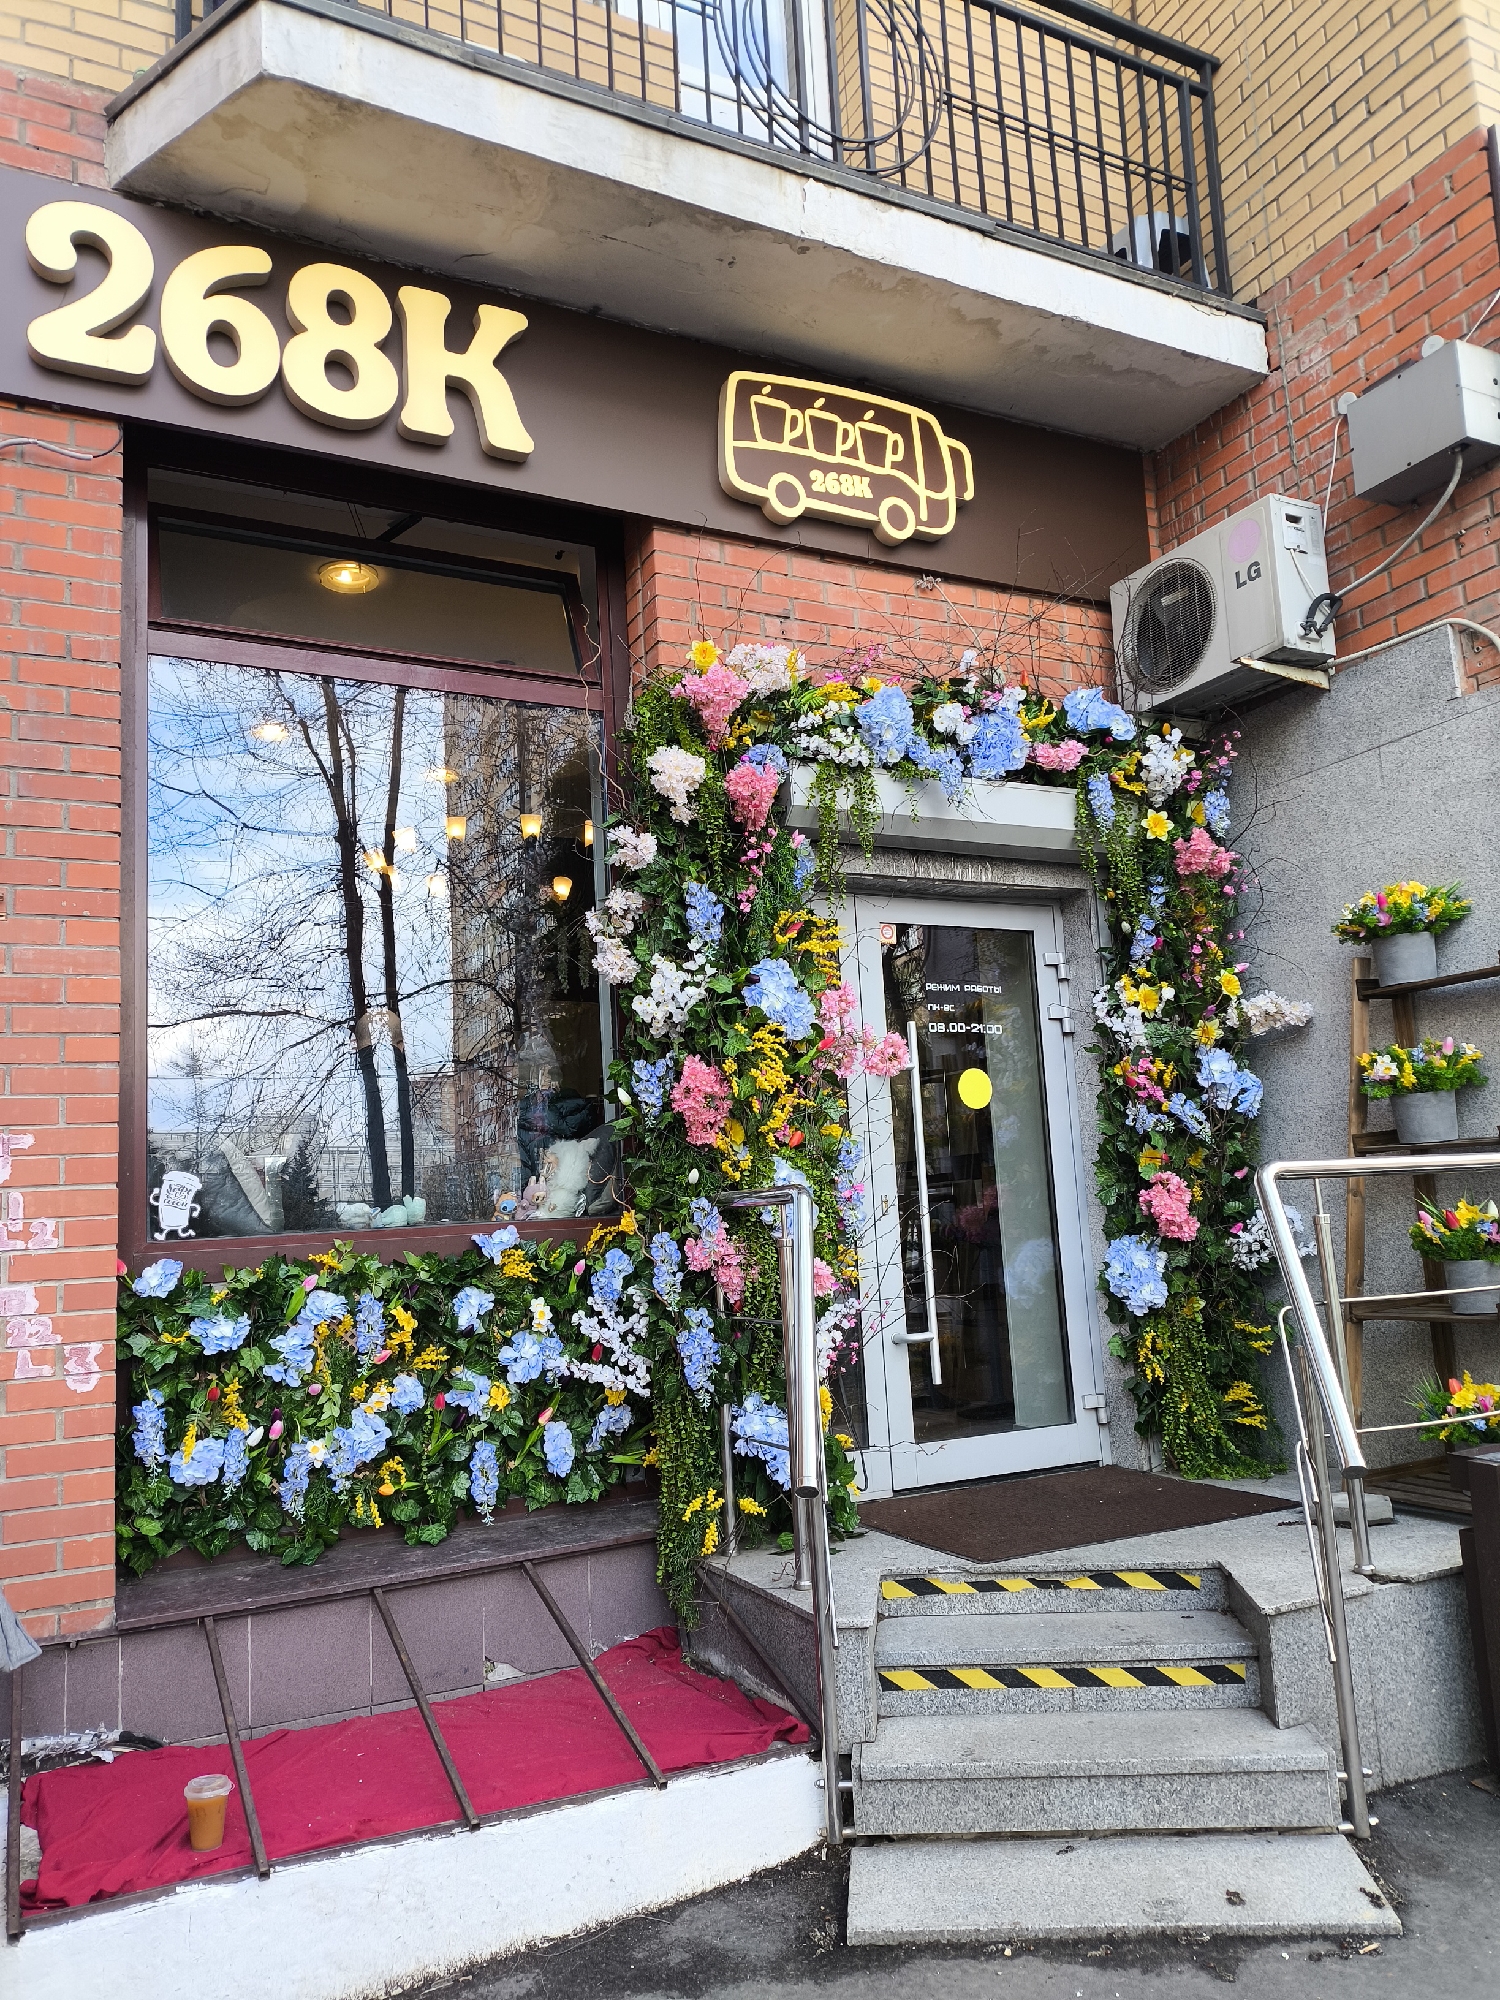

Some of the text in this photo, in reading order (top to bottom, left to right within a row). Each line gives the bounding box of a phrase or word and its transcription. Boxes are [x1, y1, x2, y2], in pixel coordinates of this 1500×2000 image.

[25, 200, 535, 462] 268K
[809, 469, 874, 499] 268K
[1235, 560, 1262, 590] LG
[925, 982, 1002, 994] РЕЖИМ РАБОТЫ
[927, 1003, 956, 1012] ПН-ВС
